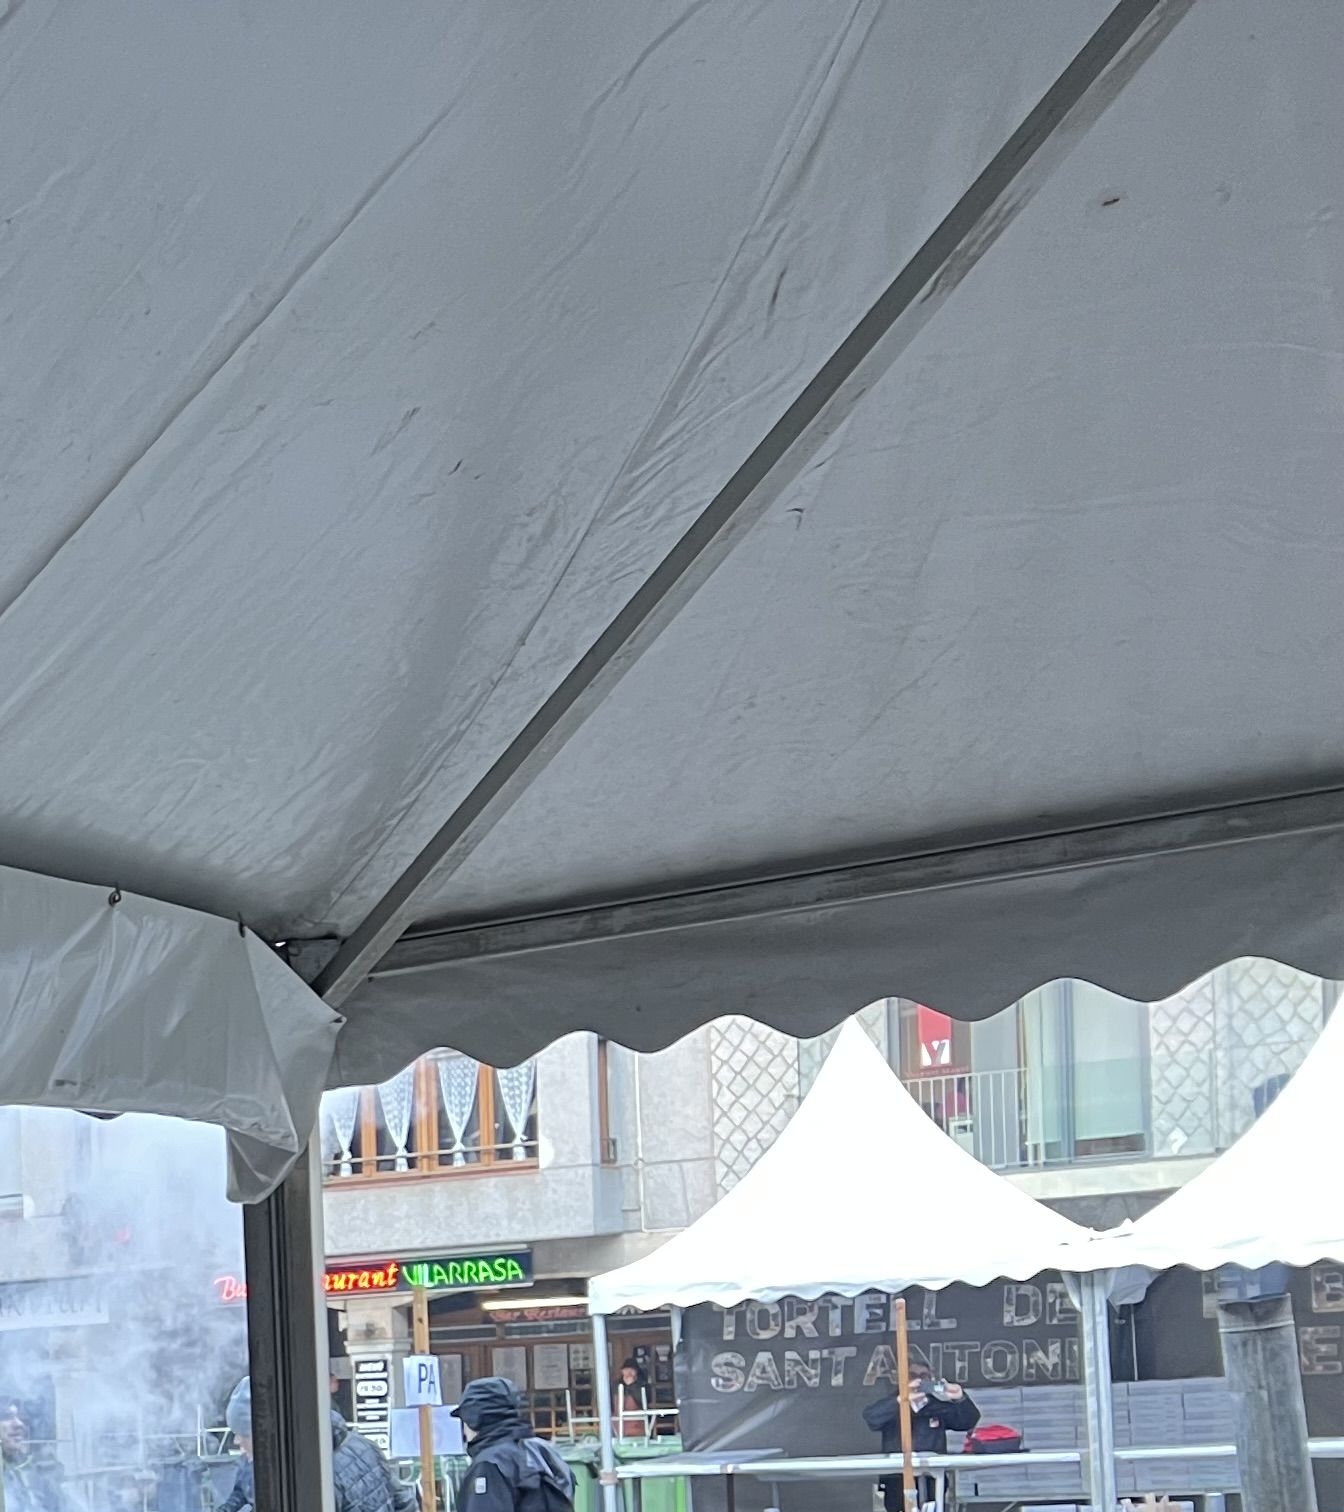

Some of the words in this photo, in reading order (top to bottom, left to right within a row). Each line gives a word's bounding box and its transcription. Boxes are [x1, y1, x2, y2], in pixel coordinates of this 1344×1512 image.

[403, 1258, 523, 1289] VILARRASA
[712, 1291, 957, 1341] TORTELL
[711, 1346, 857, 1393] SANT
[863, 1337, 1081, 1387] ANTONI
